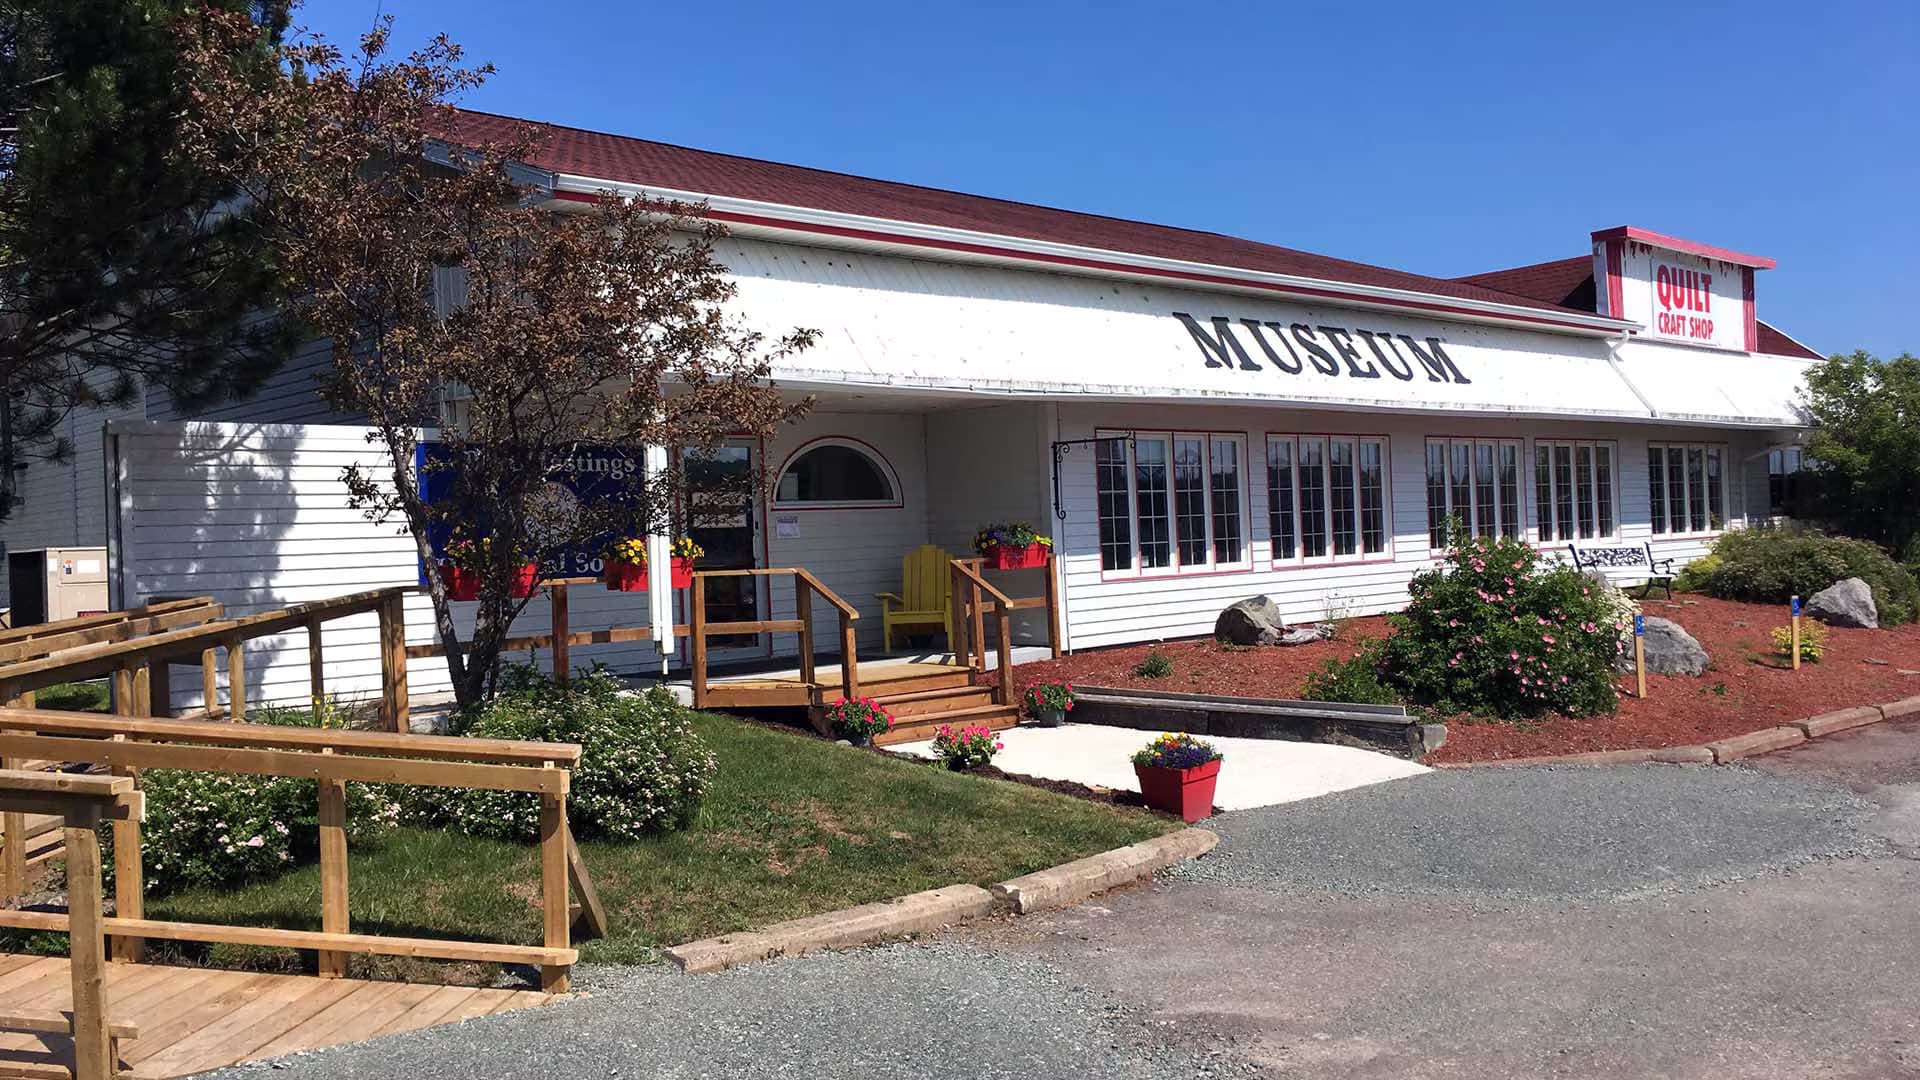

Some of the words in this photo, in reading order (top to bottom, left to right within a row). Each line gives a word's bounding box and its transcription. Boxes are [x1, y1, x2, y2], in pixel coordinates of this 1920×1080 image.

[1657, 264, 1712, 313] QUILT
[1172, 311, 1472, 384] MUSEUM
[1658, 312, 1686, 336] CRAFT
[1689, 316, 1714, 340] SHOP
